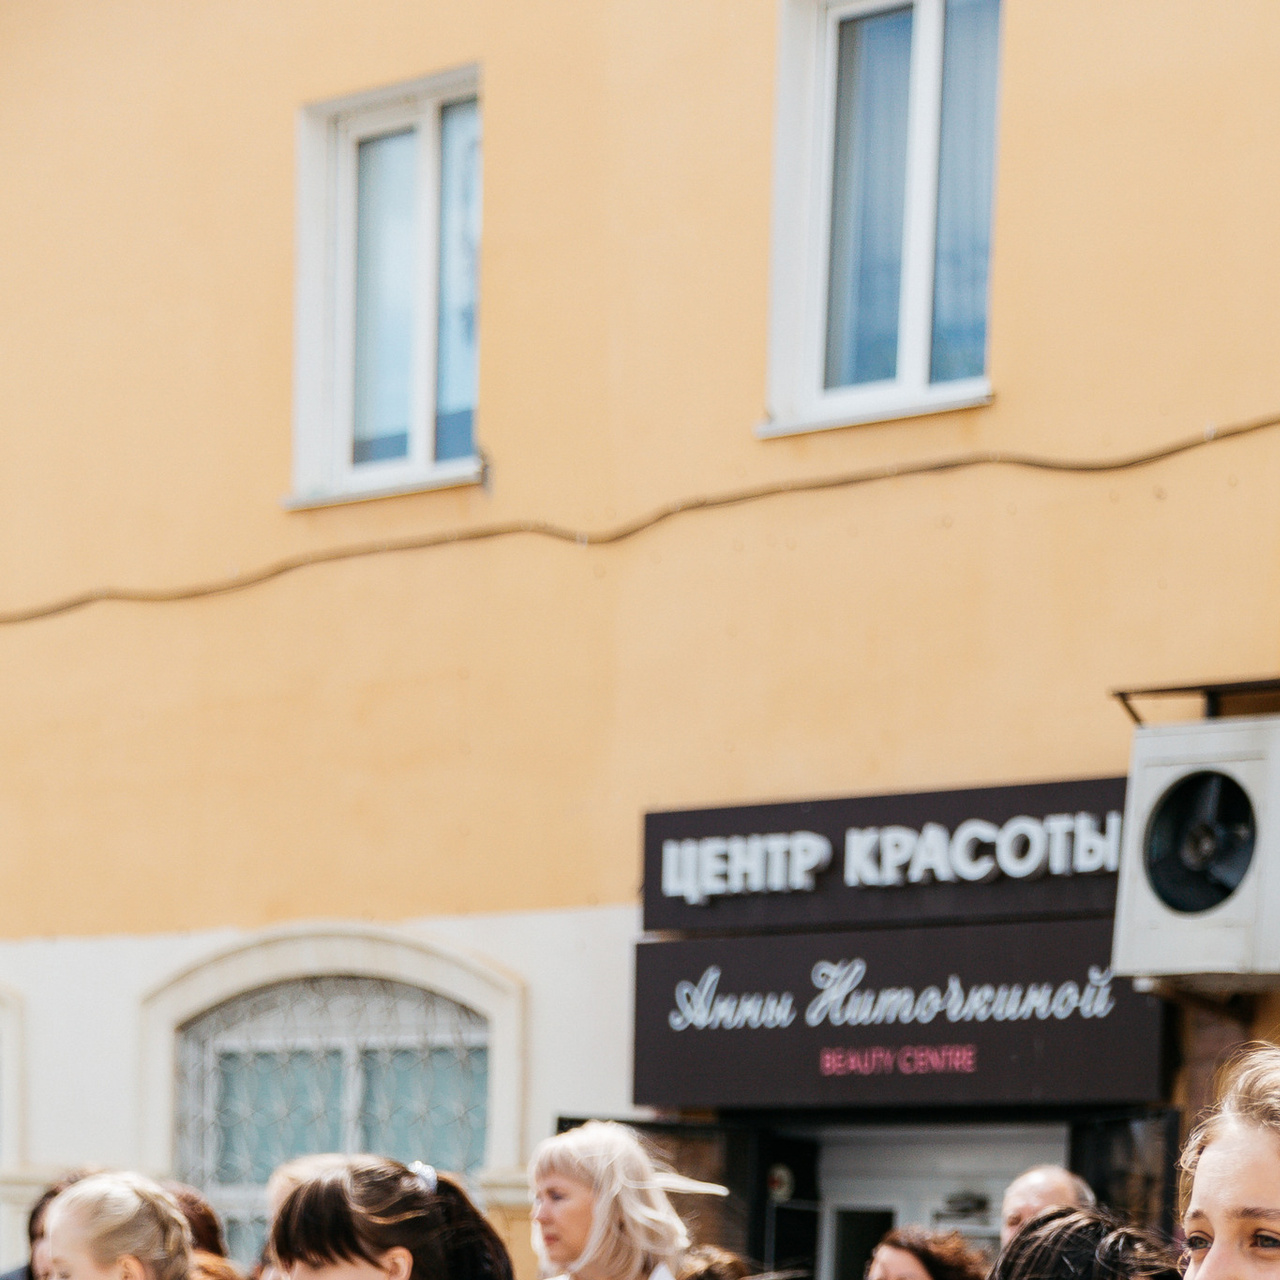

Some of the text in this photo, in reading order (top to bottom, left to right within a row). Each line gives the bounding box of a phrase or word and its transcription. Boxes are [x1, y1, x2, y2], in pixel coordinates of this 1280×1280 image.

[662, 810, 1121, 904] ЦЕНТР КРАСОТЫ
[669, 957, 1116, 1031] Анны Ниточкиной
[820, 1044, 977, 1076] BEAUTY CENTRE
